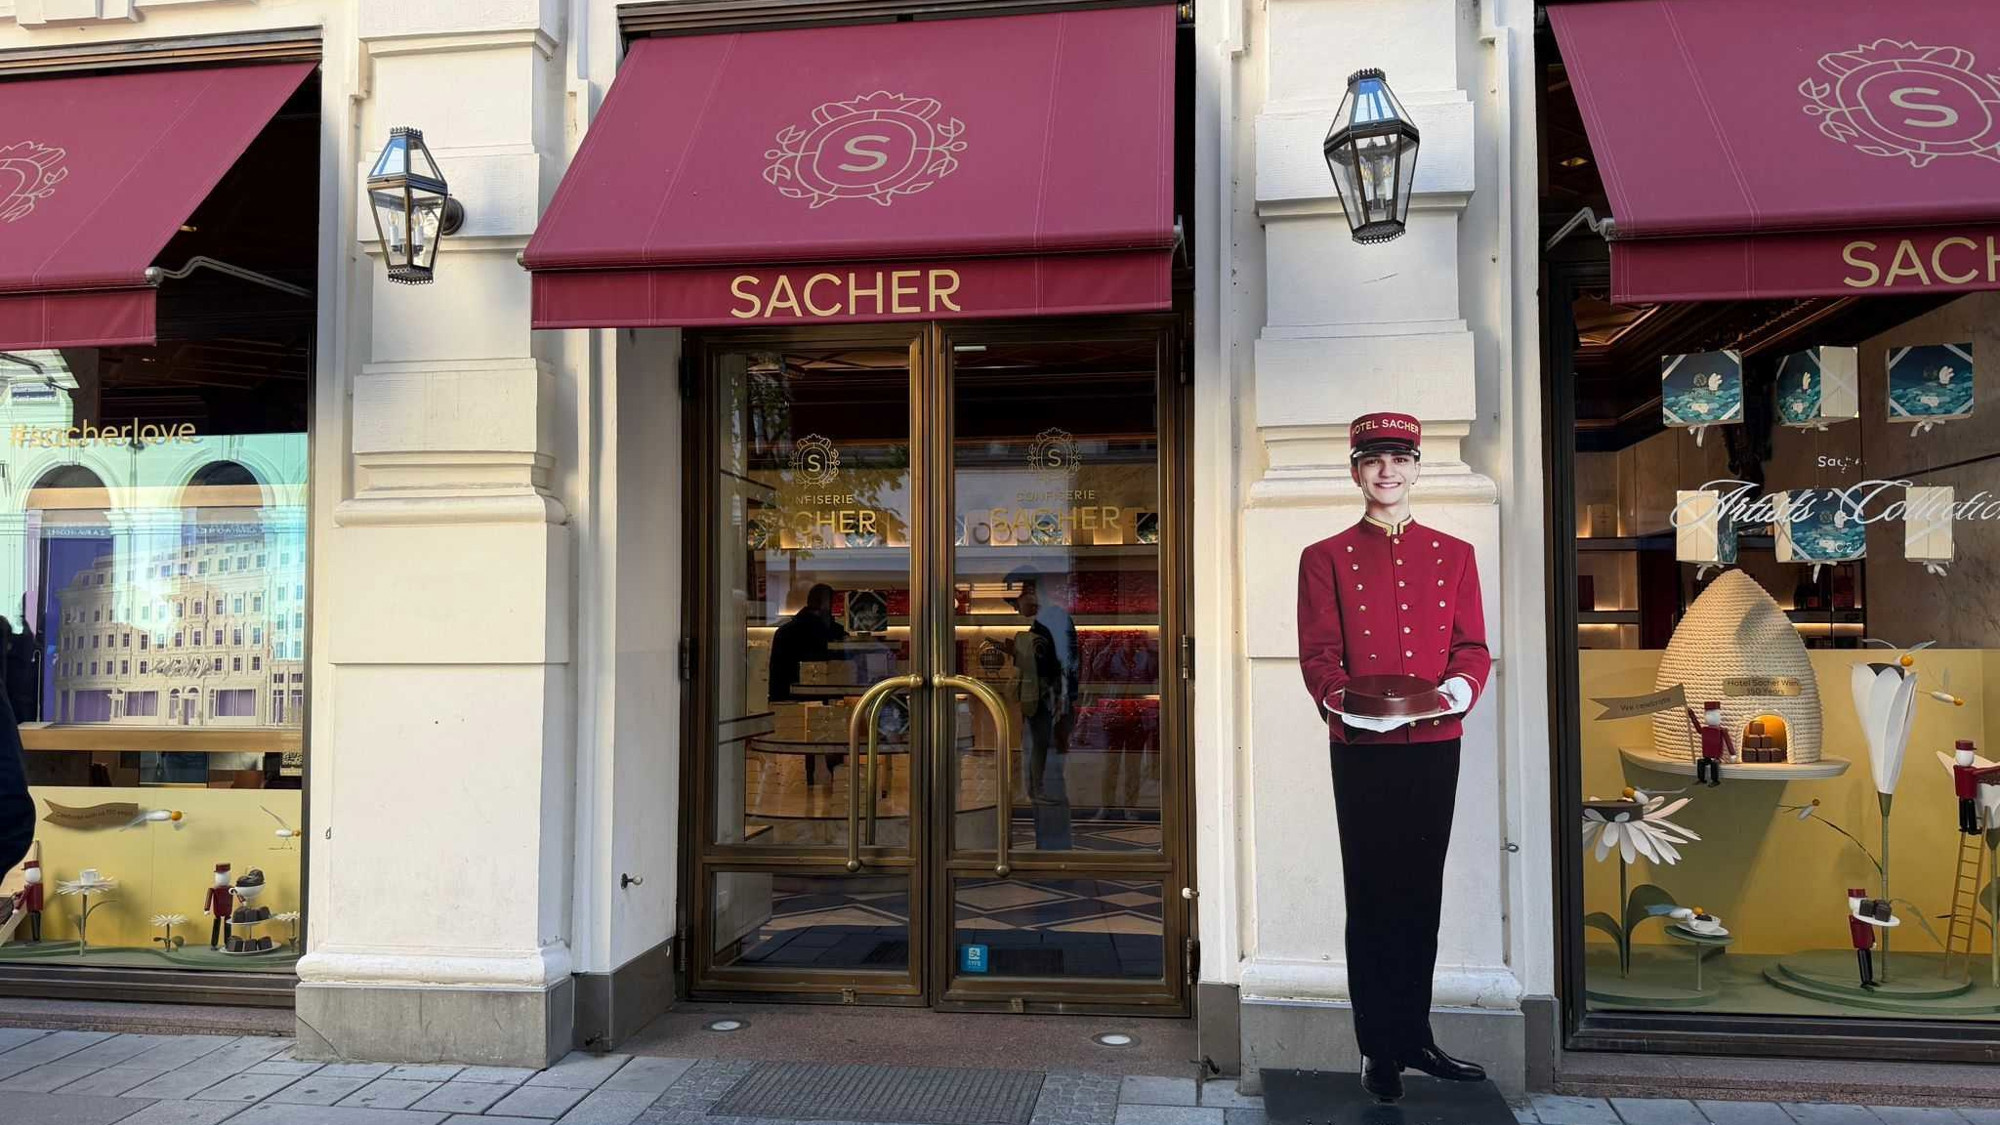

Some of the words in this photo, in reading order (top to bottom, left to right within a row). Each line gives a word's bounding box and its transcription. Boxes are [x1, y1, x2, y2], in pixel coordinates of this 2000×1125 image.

[1889, 87, 1959, 127] S
[838, 135, 891, 172] S
[730, 269, 961, 318] SACHER
[1382, 419, 1419, 434] SACHER
[808, 455, 820, 472] S
[1048, 449, 1062, 467] S
[791, 494, 853, 505] NFISERIE
[1840, 479, 2000, 524] Collectio
[795, 511, 876, 534] CHER
[989, 506, 1120, 531] SACHER
